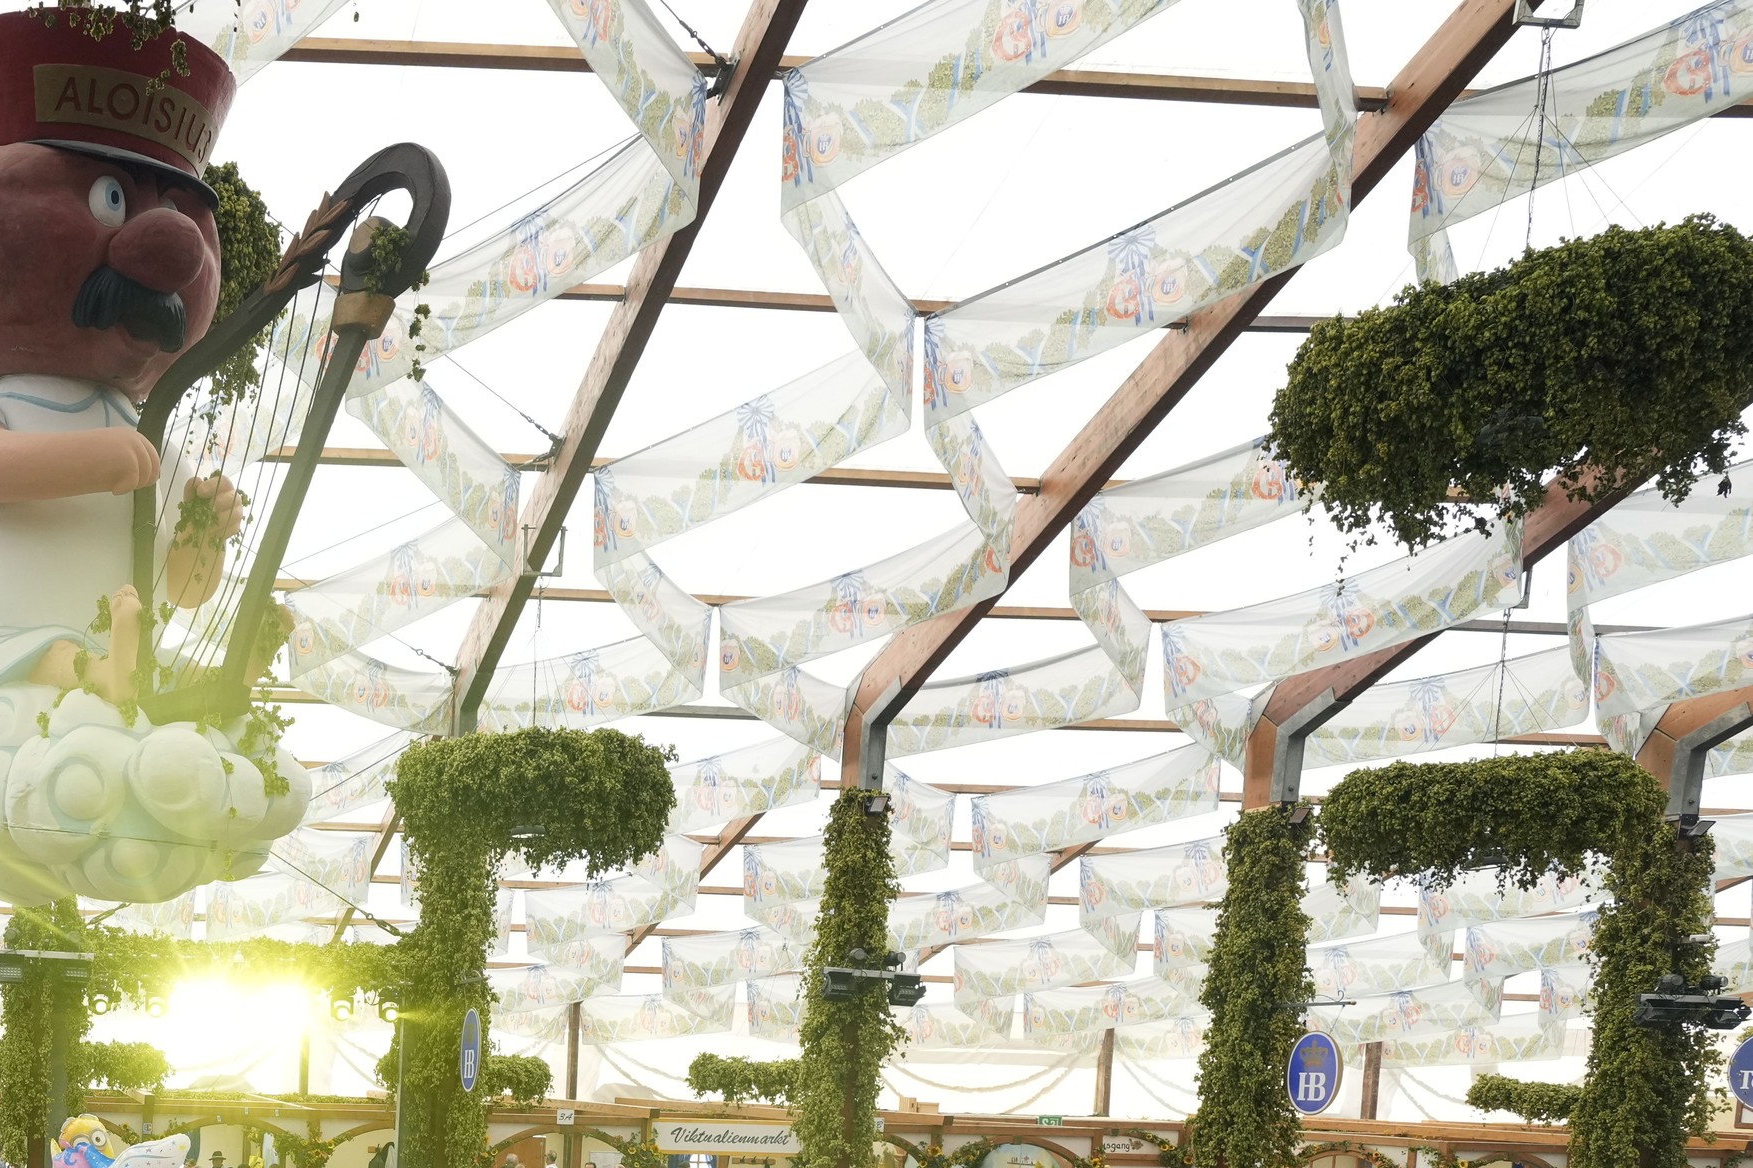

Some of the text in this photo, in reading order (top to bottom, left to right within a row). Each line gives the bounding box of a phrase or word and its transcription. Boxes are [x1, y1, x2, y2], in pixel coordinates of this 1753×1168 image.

[463, 1049, 475, 1079] HB
[1297, 1072, 1326, 1101] HB
[1740, 1069, 1753, 1090] T
[558, 1112, 573, 1121] 3A
[670, 1126, 790, 1146] Viktualienmarkt
